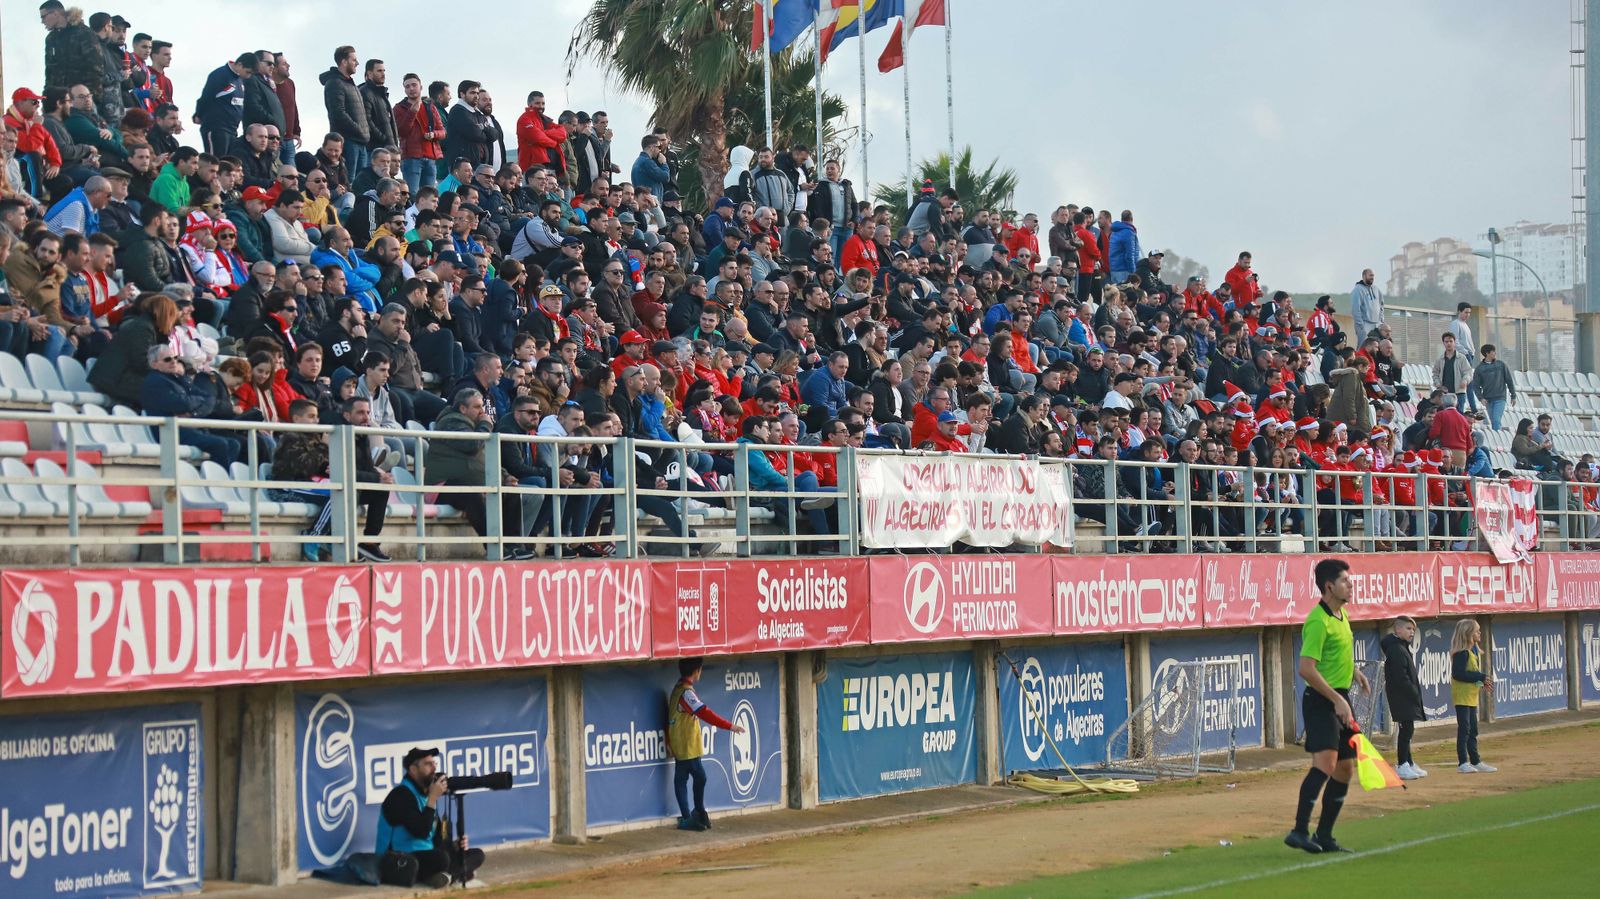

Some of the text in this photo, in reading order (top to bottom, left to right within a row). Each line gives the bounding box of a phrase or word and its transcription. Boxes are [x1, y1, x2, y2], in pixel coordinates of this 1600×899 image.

[332, 341, 351, 357] 85
[982, 500, 997, 530] EL
[678, 586, 700, 601] Algeciras
[757, 568, 847, 613] Socialistas
[952, 561, 1016, 595] HYUNDAI
[1057, 563, 1197, 627] masterhouse
[1349, 573, 1384, 605] TELES
[1386, 563, 1435, 603] ALBORÁN
[74, 578, 313, 679] PADILLA
[421, 565, 646, 665] PURO ESTRECHO
[678, 606, 700, 631] PSOE
[758, 620, 768, 640] de
[769, 618, 804, 644] Algeciras
[953, 601, 1019, 632] PERMOTOR
[725, 669, 761, 691] ŠKODA
[1049, 664, 1103, 715] populares
[842, 672, 955, 731] EUROPEA
[146, 727, 186, 755] GRUPO
[584, 721, 667, 766] Grazalema
[922, 729, 956, 753] GROUP
[1055, 708, 1104, 745] de Algeciras
[0, 732, 115, 760] BILIARIO DE OFICINA
[370, 743, 534, 790] EUGRUAS
[0, 803, 132, 879] lgeToner
[55, 877, 74, 892] todo
[75, 876, 93, 894] para
[94, 873, 103, 886] la
